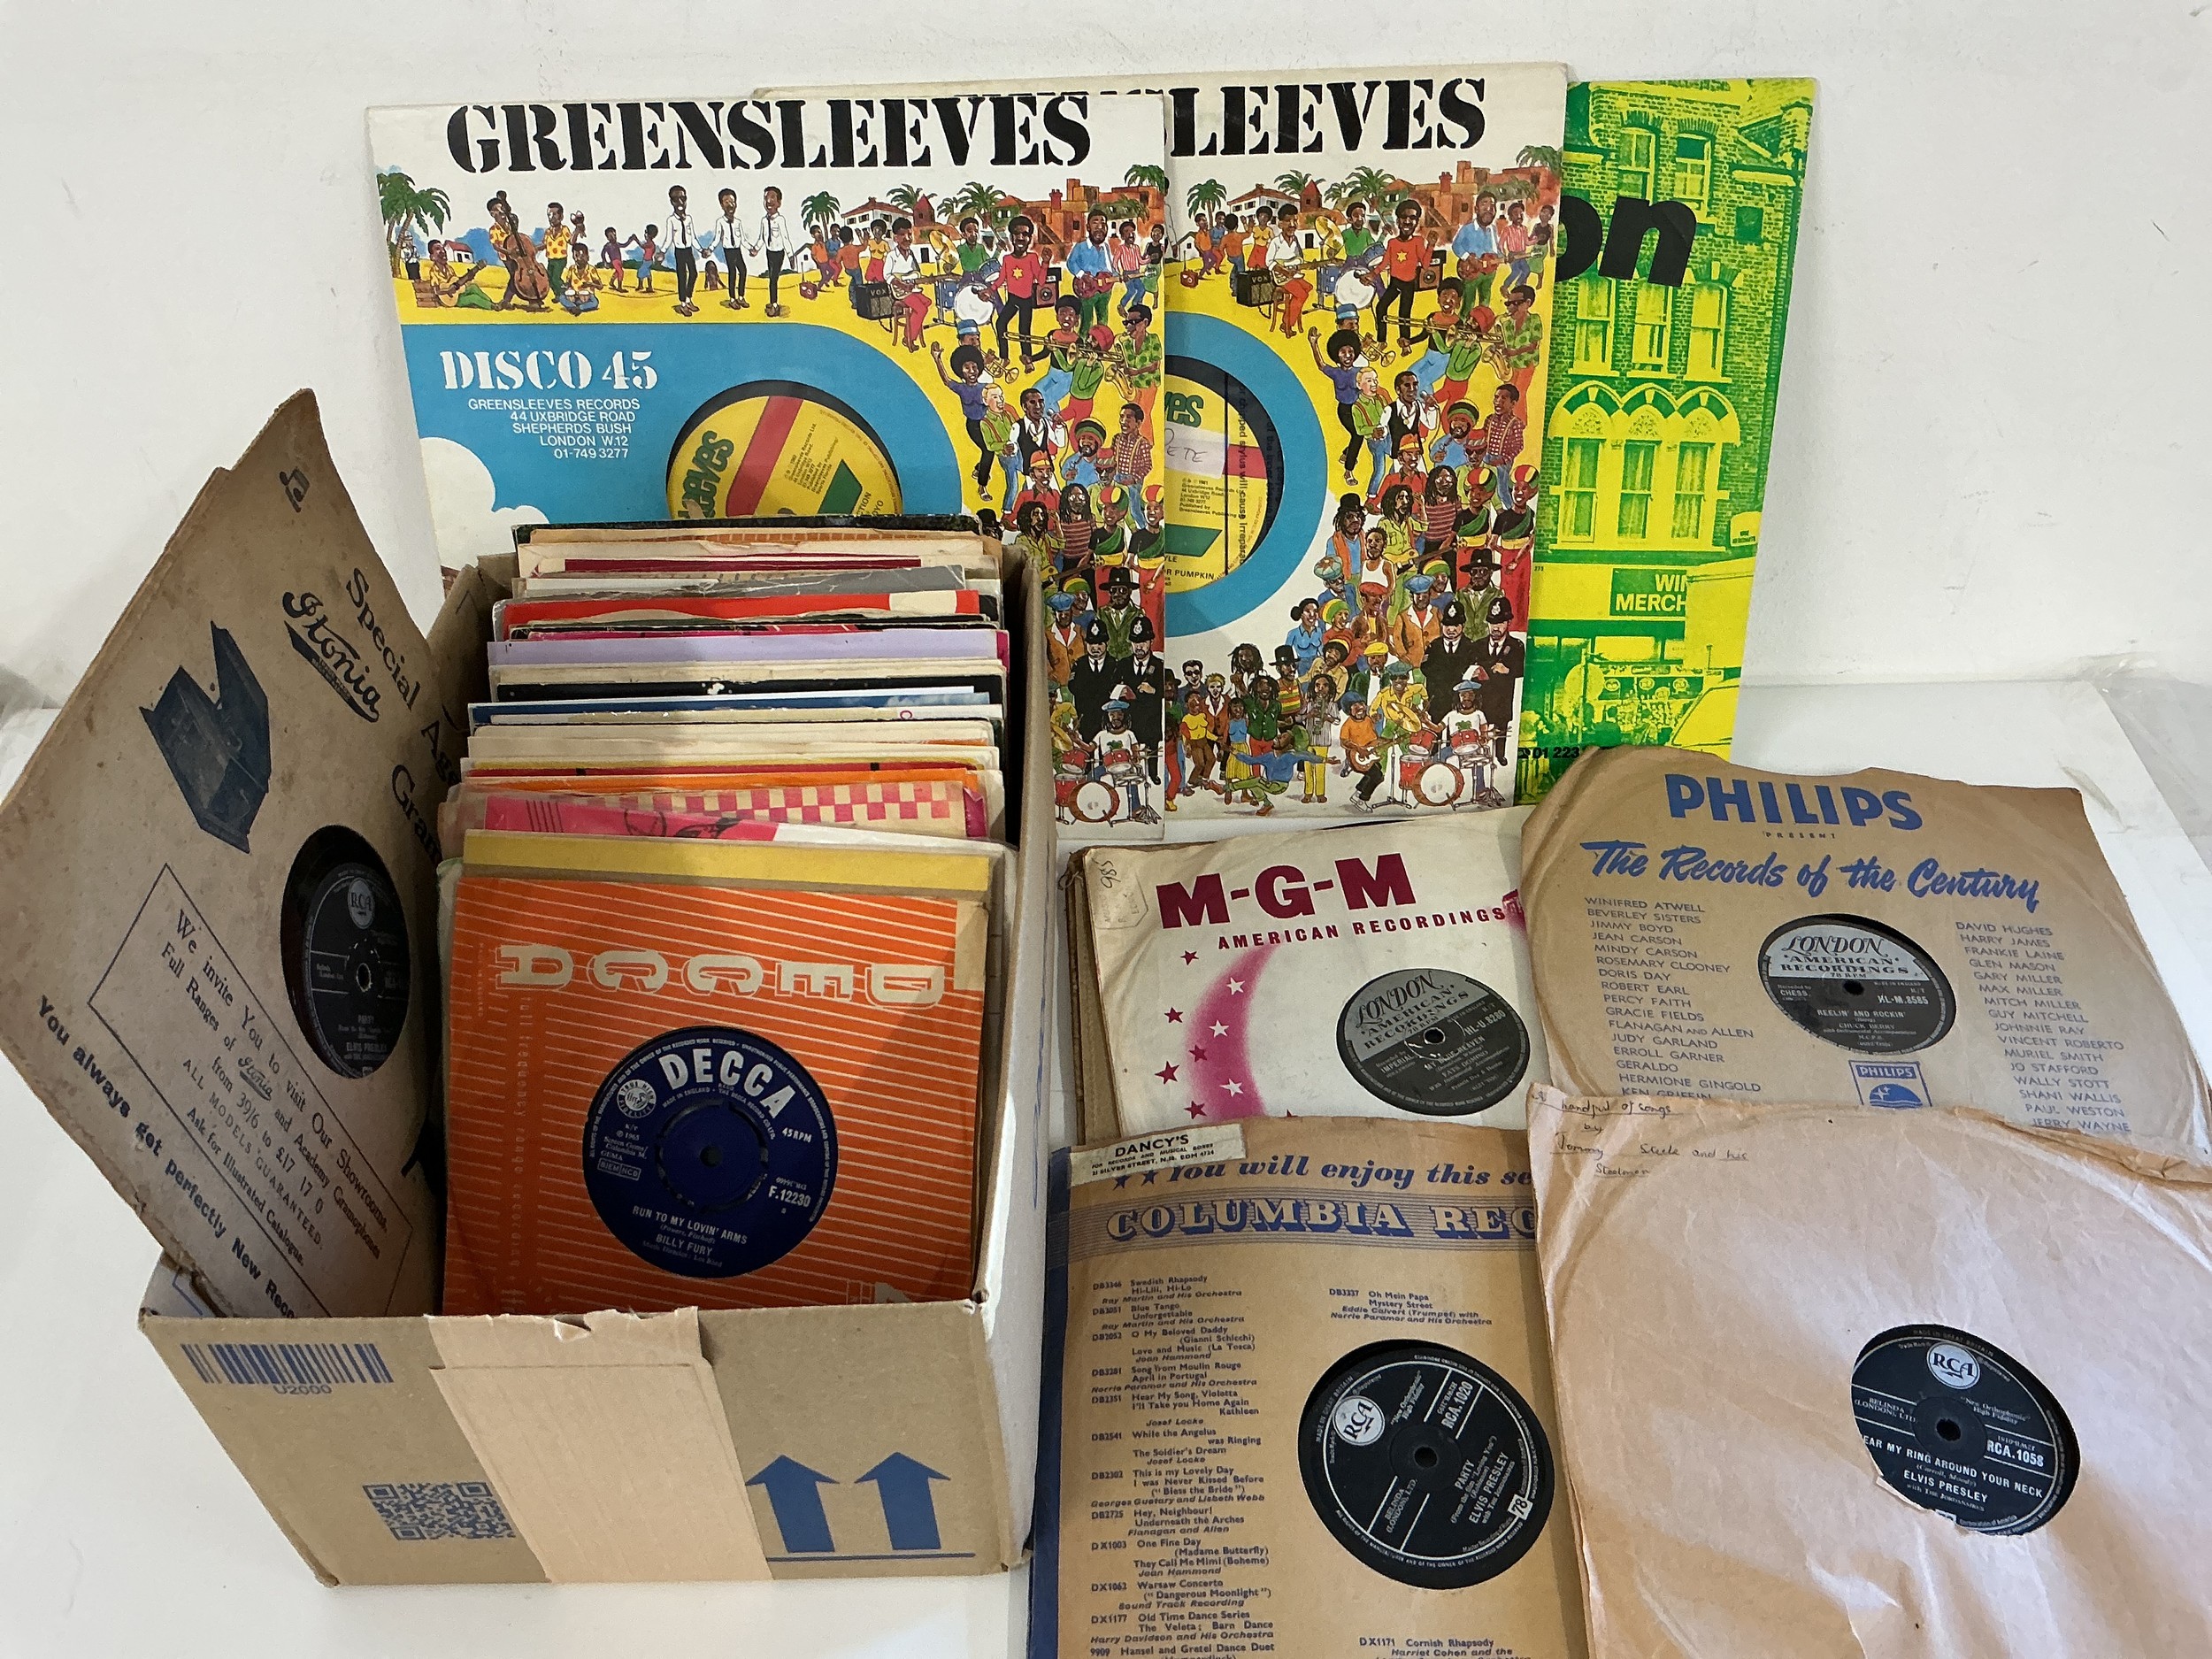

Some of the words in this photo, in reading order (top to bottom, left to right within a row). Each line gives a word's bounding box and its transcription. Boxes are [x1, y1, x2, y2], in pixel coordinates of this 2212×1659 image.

[1164, 78, 1486, 157] LEEVES
[446, 94, 1091, 173] GREENSLEEVES
[440, 350, 592, 390] DISCO
[602, 350, 658, 389] 45
[468, 399, 572, 410] GREENSLEEVES
[577, 399, 640, 410] RECORDS
[511, 411, 526, 421] 44
[531, 411, 595, 422] UXBRIDGE
[600, 411, 635, 422] ROAD
[513, 423, 591, 434] SHEPHERDS
[596, 423, 632, 434] BUSH
[541, 435, 595, 446] LONDON
[601, 436, 628, 446] W.12
[554, 449, 596, 458] 01-749
[600, 449, 627, 458] 3277
[1175, 569, 1214, 580] PUMPKIN
[346, 567, 420, 711] Special
[1532, 747, 1548, 758] 01
[1553, 747, 1579, 758] 223
[1664, 773, 1923, 831] PHILIPS
[1580, 840, 1648, 877] The
[1660, 845, 1788, 887] Records
[1798, 856, 1832, 897] of
[1840, 858, 1895, 891] the
[1907, 857, 2039, 913] Century
[1156, 852, 1417, 929] M-G-M
[350, 892, 373, 912] RCA
[1585, 897, 1647, 909] WINIFRED
[1655, 902, 1705, 912] ATWELL
[1587, 909, 1647, 920] BEVERLEY
[1654, 913, 1701, 923] SISTERS
[1217, 925, 1339, 949] AMERICAN
[1353, 906, 1505, 936] RECORDINGS
[1955, 922, 1996, 932] DAVID
[2002, 926, 2053, 936] HUGHES
[1631, 934, 1682, 945] CARSON
[1781, 936, 1889, 957] LONDON
[1597, 956, 1664, 968] ROSEMARY
[1671, 962, 1731, 973] CLOONEY
[1965, 947, 2019, 957] FRANKIE
[2026, 950, 2065, 961] LAINE
[1599, 969, 1637, 979] DORIS
[1644, 972, 1671, 980] DAY
[1780, 964, 1909, 974] RECORDINGS
[1356, 971, 1444, 1029] LONDON
[1364, 990, 1470, 1049] RECORDINGS
[1606, 1007, 1655, 1018] GRACIE
[1662, 1011, 1704, 1021] FIELDS
[1989, 1010, 2015, 1018] GUY
[2024, 1011, 2088, 1023] MITCHELL
[177, 909, 196, 954] We
[203, 955, 234, 1007] invite
[241, 1005, 264, 1050] You
[268, 1053, 280, 1073] to
[286, 1080, 307, 1112] visit
[312, 1112, 334, 1148] Our
[1611, 1033, 1645, 1043] JUDY
[1653, 1036, 1718, 1048] GARLAND
[1998, 1035, 2058, 1046] VINCENT
[2065, 1039, 2124, 1050] ROBERTO
[161, 941, 184, 979] Full
[185, 977, 219, 1032] Ranges
[224, 1035, 236, 1052] of
[274, 1109, 292, 1133] and
[294, 1133, 330, 1188] Academy
[1380, 1053, 1415, 1074] IMPERIAL
[1617, 1060, 1678, 1071] GERALDO
[1859, 1067, 1913, 1078] PHILIPS
[658, 1048, 795, 1118] DECCA
[182, 1058, 204, 1090] ALL
[209, 1091, 252, 1155] MODELS
[2020, 1090, 2062, 1101] SHANI
[2069, 1093, 2122, 1103] WALLIS
[37, 994, 70, 1046] You
[73, 1046, 132, 1118] always
[134, 1121, 163, 1157] get
[165, 1158, 227, 1239] perfectly
[231, 1237, 262, 1280] New
[211, 1056, 234, 1094] from
[236, 1092, 259, 1128] 39/6
[262, 1130, 272, 1148] to
[275, 1147, 296, 1173] £17
[299, 1176, 313, 1197] 17
[1115, 1133, 1189, 1157] DANCY'S
[1692, 1149, 1717, 1158] and
[1726, 1148, 1747, 1160] his
[187, 1107, 206, 1136] Ask
[206, 1131, 222, 1155] for
[222, 1151, 266, 1214] Illustrated
[1168, 1162, 1228, 1184] You
[1239, 1153, 1310, 1177] will
[1321, 1158, 1415, 1190] enjoy
[1426, 1162, 1490, 1185] this
[768, 1185, 811, 1208] F.12230
[632, 1205, 652, 1218] RUN
[656, 1211, 667, 1221] TO
[670, 1216, 685, 1227] MY
[687, 1219, 720, 1236] LOVIN'
[720, 1229, 748, 1245] ARMS
[1106, 1197, 1416, 1241] COLUMBIA
[656, 1233, 685, 1248] BILLY
[687, 1243, 713, 1256] FURY
[1932, 1351, 1975, 1378] RCA
[271, 1383, 333, 1396] U2000
[1440, 1380, 1474, 1430] RCA.1020
[1343, 1401, 1375, 1440] RCA
[1133, 1430, 1161, 1439] While
[1180, 1428, 1217, 1437] Angelus
[1986, 1440, 2045, 1468] RCA.1058
[1454, 1460, 1475, 1490] PARTY
[1863, 1434, 1883, 1448] EAR
[1886, 1442, 1902, 1455] MY
[1906, 1449, 1932, 1463] RING
[1934, 1457, 1978, 1478] AROUND
[1981, 1471, 2010, 1488] YOUR
[2014, 1482, 2044, 1499] NECK
[1468, 1494, 1488, 1524] ELVIS
[1483, 1452, 1509, 1494] PRESLEY
[1903, 1470, 1935, 1487] ELVIS
[1939, 1480, 1988, 1502] PRESLEY
[1512, 1498, 1528, 1516] 78
[1136, 1540, 1157, 1548] One
[1183, 1538, 1202, 1548] Day
[1120, 1645, 1154, 1656] Hansel
[1158, 1645, 1177, 1654] and
[1180, 1644, 1212, 1653] Gretel
[1217, 1643, 1247, 1652] Dance
[1251, 1642, 1274, 1651] Duet
